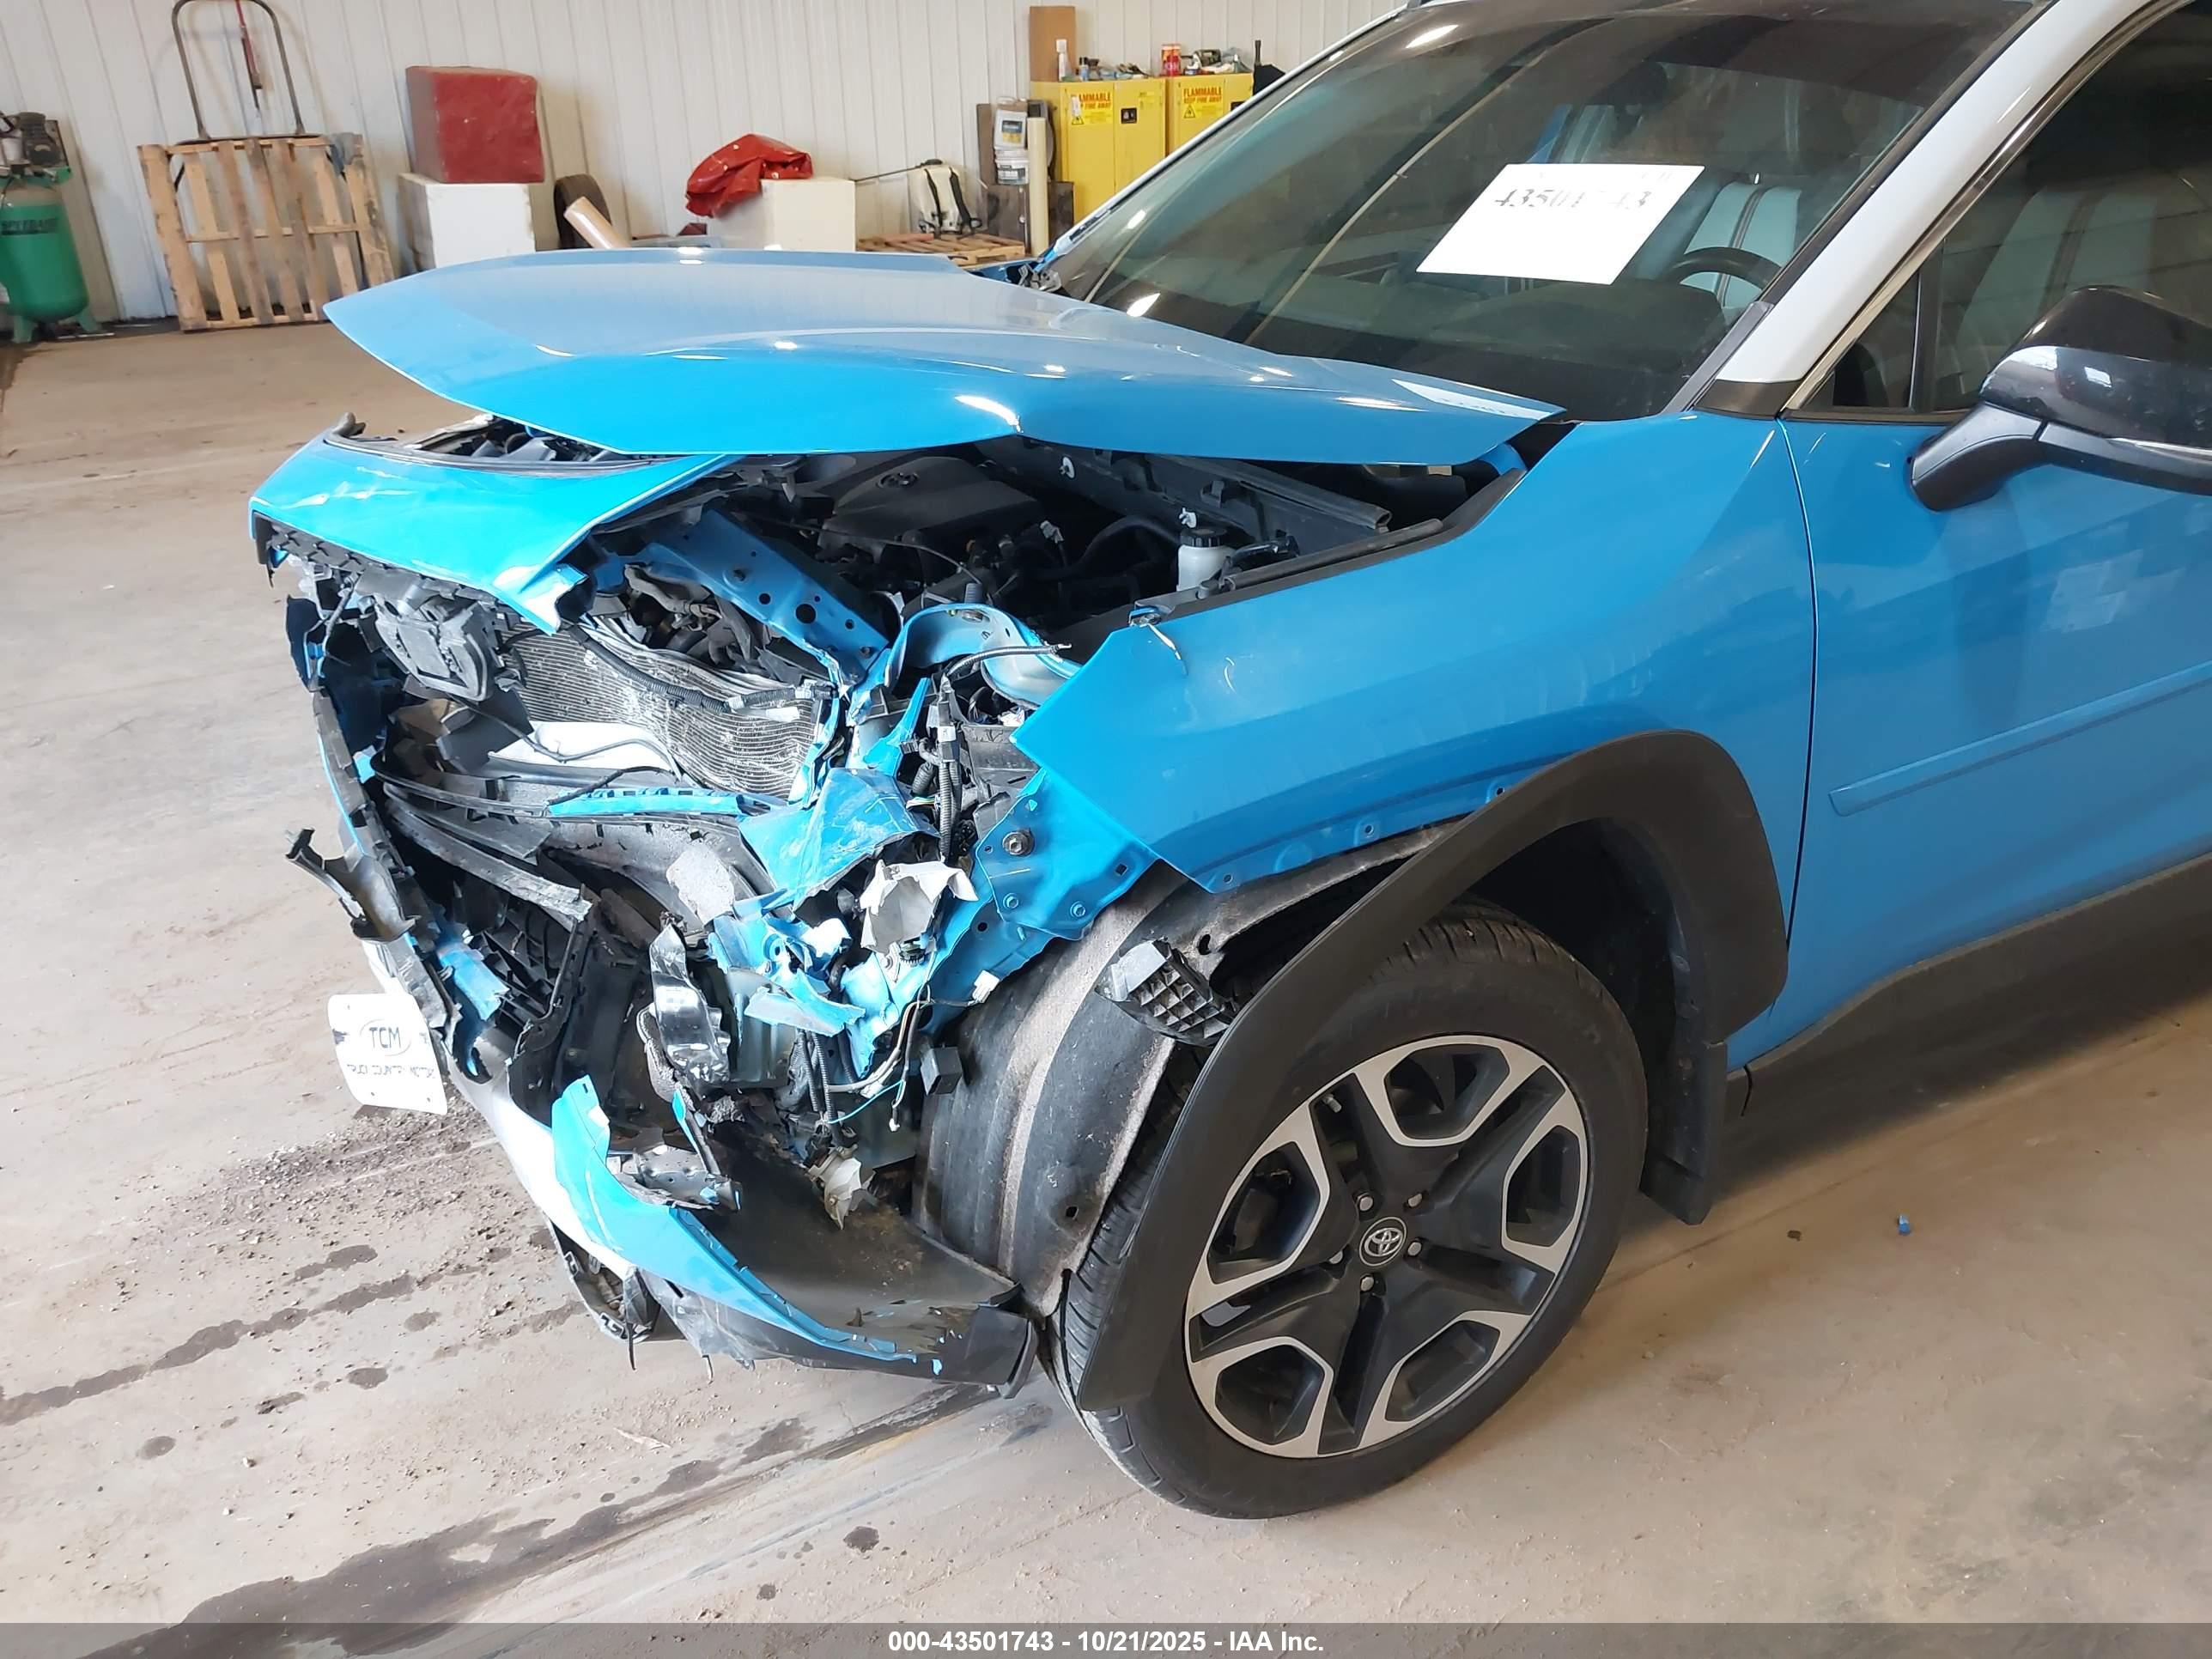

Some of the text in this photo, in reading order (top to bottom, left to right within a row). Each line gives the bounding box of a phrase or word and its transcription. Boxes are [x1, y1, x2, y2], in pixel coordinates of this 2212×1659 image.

[1079, 92, 1111, 102] AMMABLE
[1183, 87, 1222, 97] FLAMMABLE
[368, 1026, 402, 1048] TCM
